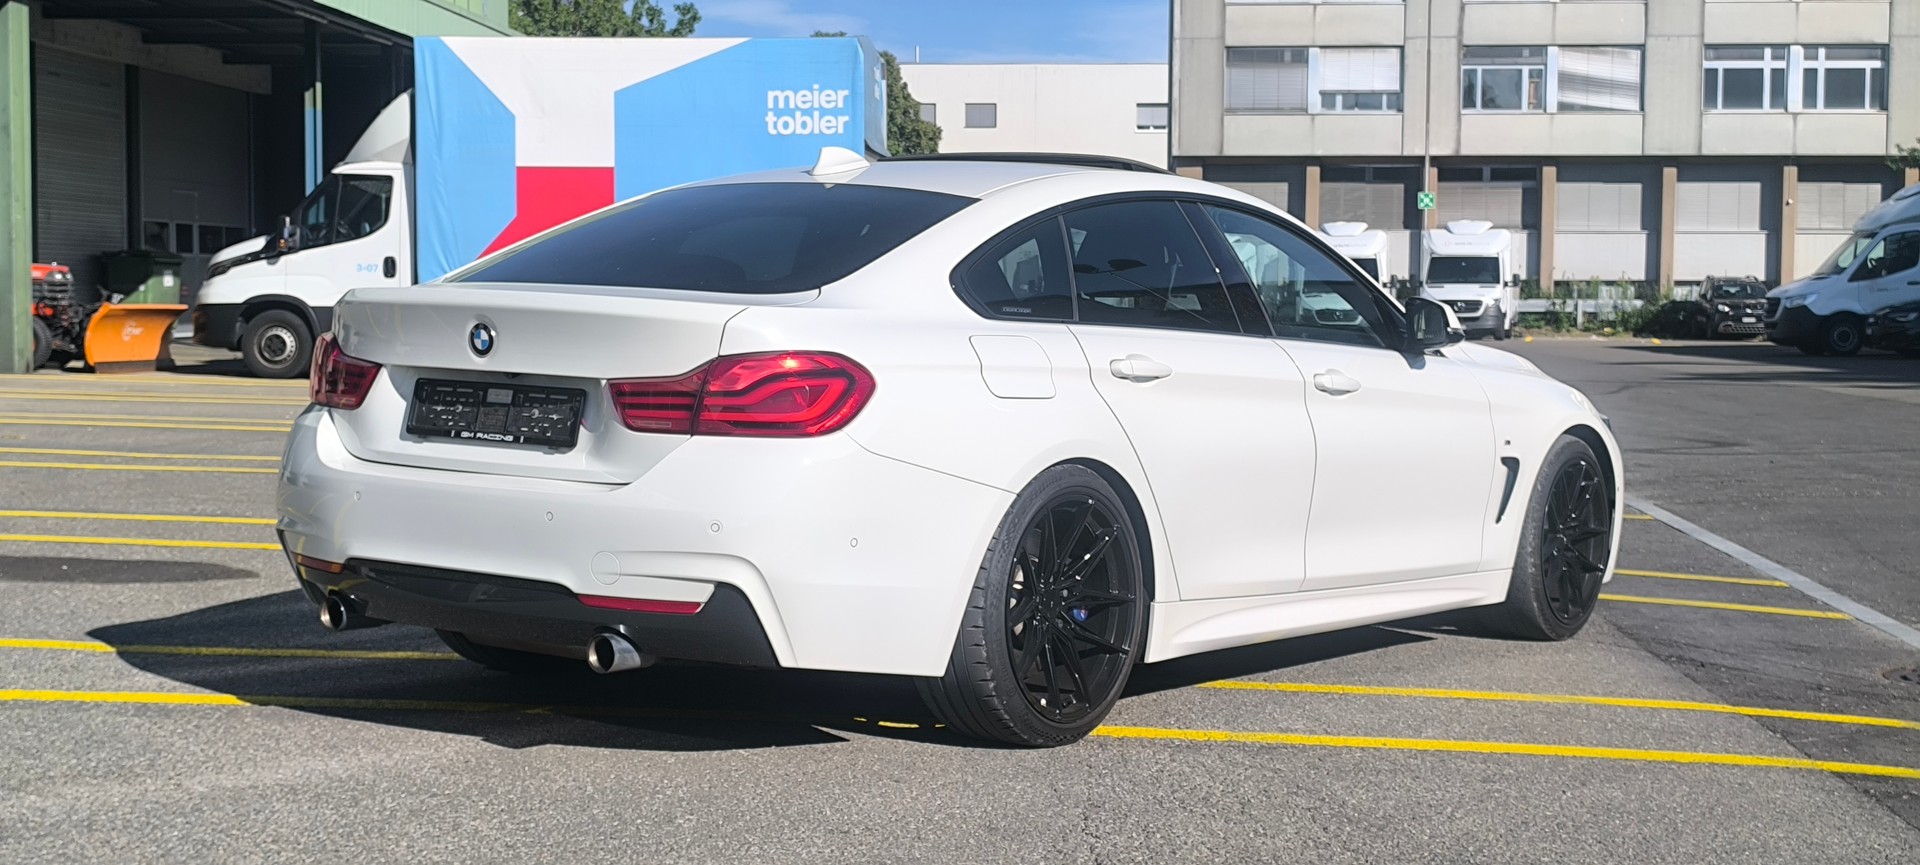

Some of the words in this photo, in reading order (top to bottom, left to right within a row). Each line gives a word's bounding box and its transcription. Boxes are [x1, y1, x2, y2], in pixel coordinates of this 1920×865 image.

[767, 84, 849, 109] meier
[765, 110, 849, 135] tobler
[356, 263, 379, 273] 3-07
[475, 432, 514, 442] RACING
